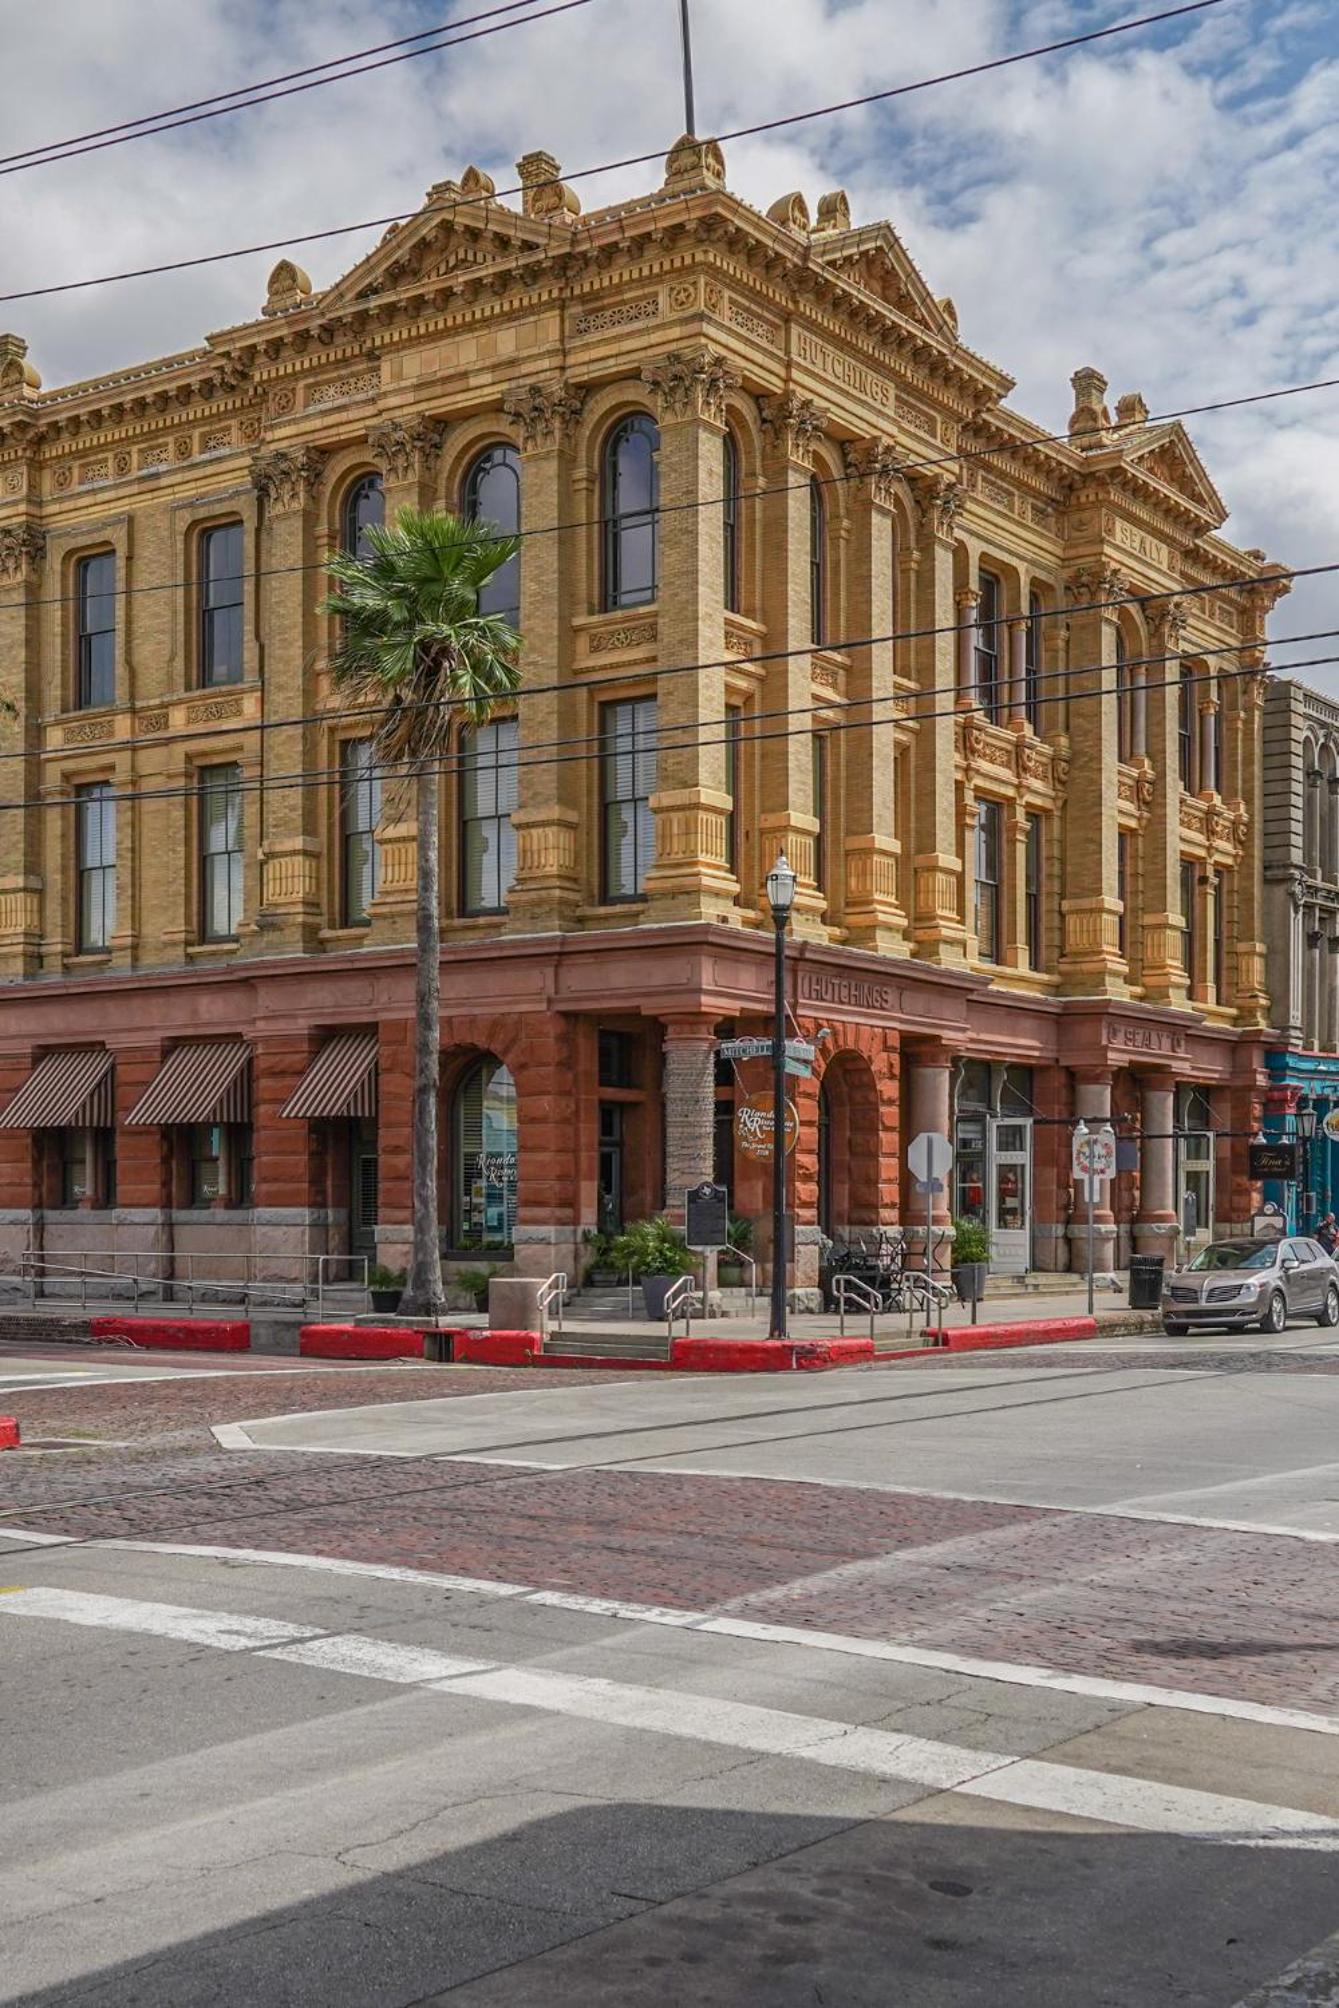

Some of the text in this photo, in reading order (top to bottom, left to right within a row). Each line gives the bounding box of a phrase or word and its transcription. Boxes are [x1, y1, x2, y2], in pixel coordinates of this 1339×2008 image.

[798, 335, 891, 408] HUTCHINGS
[1120, 525, 1163, 565] SEALY
[809, 976, 891, 1010] HUTCHINGS
[722, 1045, 769, 1057] MITCHELL
[1124, 1027, 1164, 1051] SEALY
